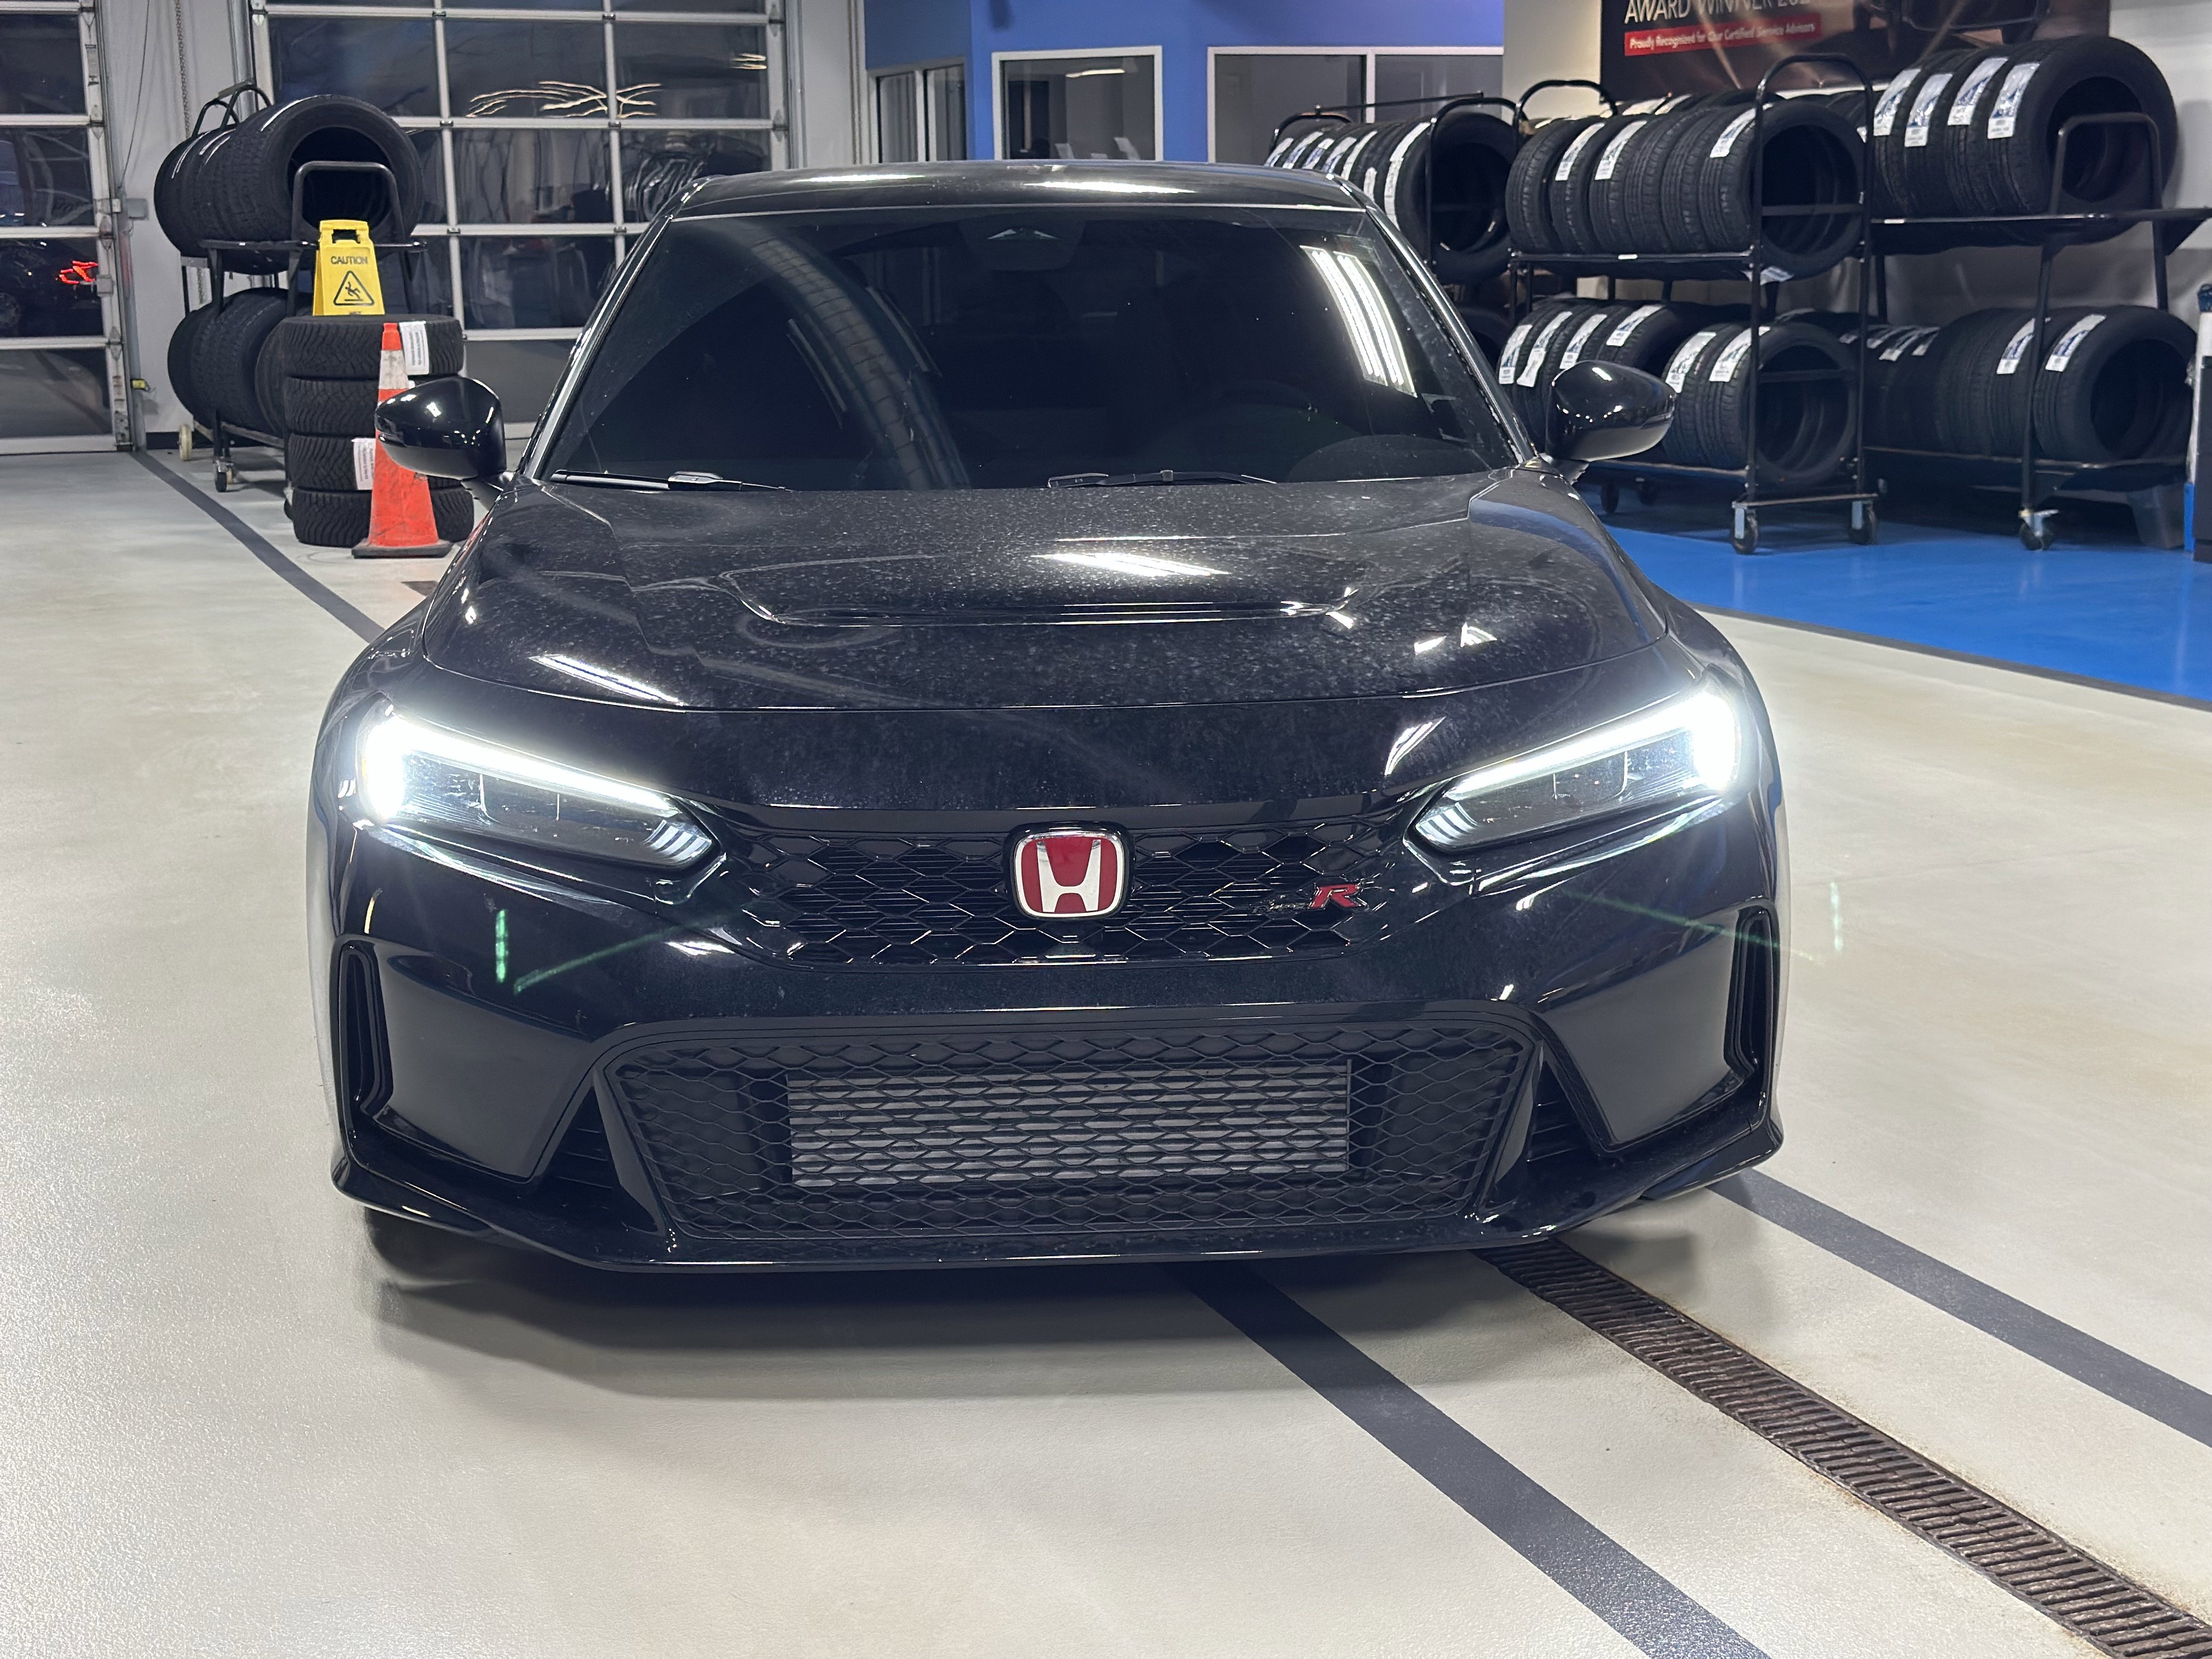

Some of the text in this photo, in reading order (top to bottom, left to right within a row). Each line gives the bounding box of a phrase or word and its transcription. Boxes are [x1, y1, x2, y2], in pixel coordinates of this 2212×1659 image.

[1624, 0, 1691, 24] AWARD
[330, 256, 369, 264] CAUTION
[1308, 883, 1361, 910] R
